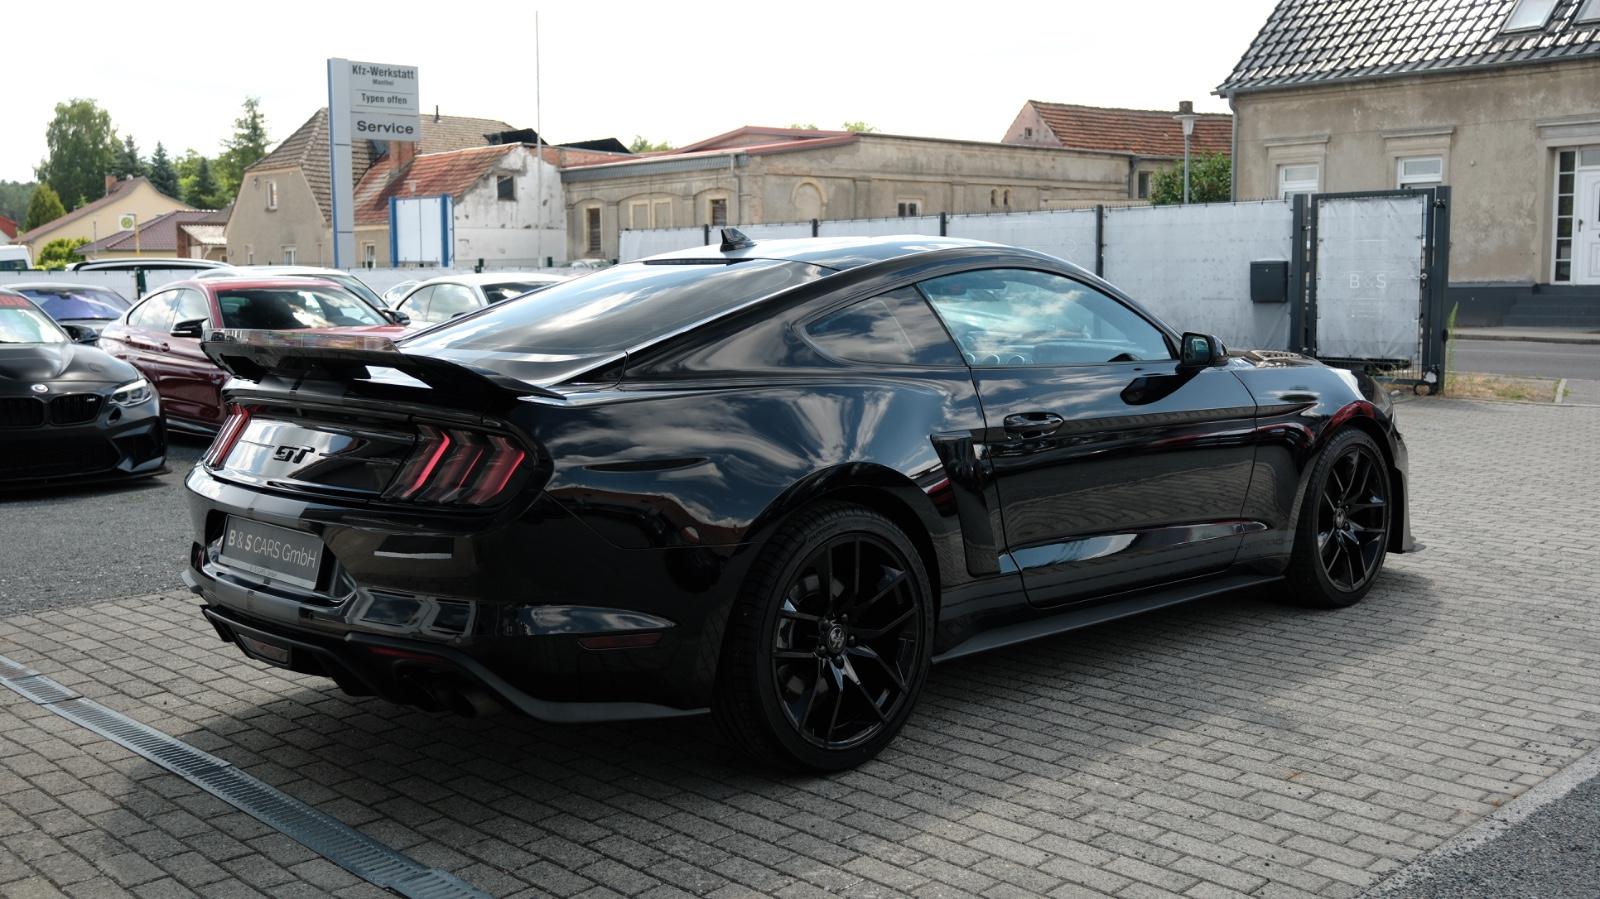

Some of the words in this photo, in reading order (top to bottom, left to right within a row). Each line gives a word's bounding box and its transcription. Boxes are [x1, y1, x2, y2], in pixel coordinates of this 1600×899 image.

[352, 64, 414, 80] Kfz-Werkstatt
[361, 93, 385, 104] Typen
[387, 95, 407, 105] offen
[357, 120, 414, 134] Service
[1349, 273, 1360, 289] B
[1375, 273, 1386, 289] S
[273, 445, 315, 464] GT
[228, 529, 236, 546] B
[237, 534, 243, 549] &
[244, 534, 253, 551] S
[253, 536, 281, 559] CARS
[281, 543, 317, 569] GmbH
